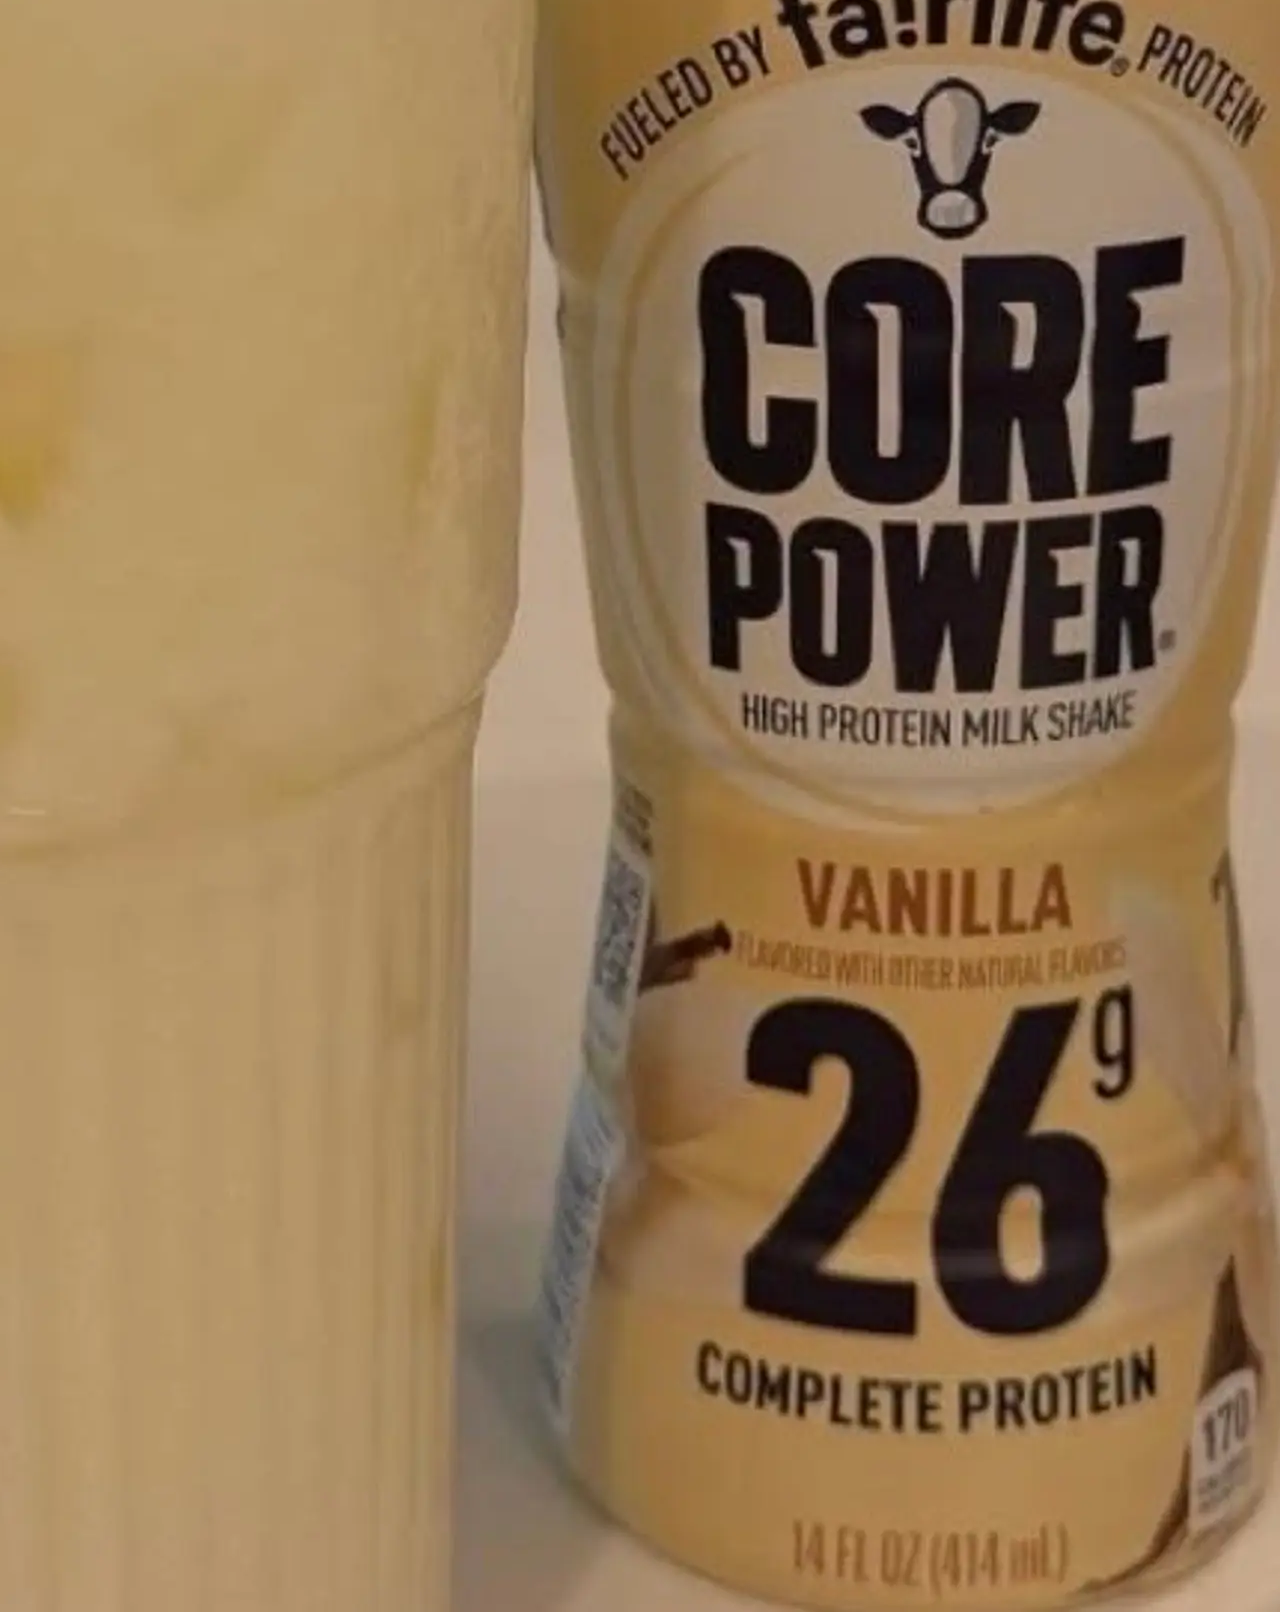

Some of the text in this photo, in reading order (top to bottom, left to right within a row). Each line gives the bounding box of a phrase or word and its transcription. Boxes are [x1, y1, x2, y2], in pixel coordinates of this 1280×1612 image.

[601, 25, 770, 179] FUELED BY
[1139, 24, 1266, 149] PROTEIN
[697, 236, 1184, 505] CORE
[705, 502, 1165, 693] POWER
[741, 691, 1136, 746] HIGH PROTEIN MILK SHAKE
[797, 858, 1073, 937] VANILLA
[836, 945, 883, 987] WITH
[958, 949, 1042, 989] NATURAL
[696, 1340, 1158, 1432] COMPLETE PROTEIN
[1203, 1388, 1250, 1462] 170
[793, 1518, 825, 1576] 14
[836, 1524, 868, 1582] FL
[880, 1528, 922, 1587] OZ
